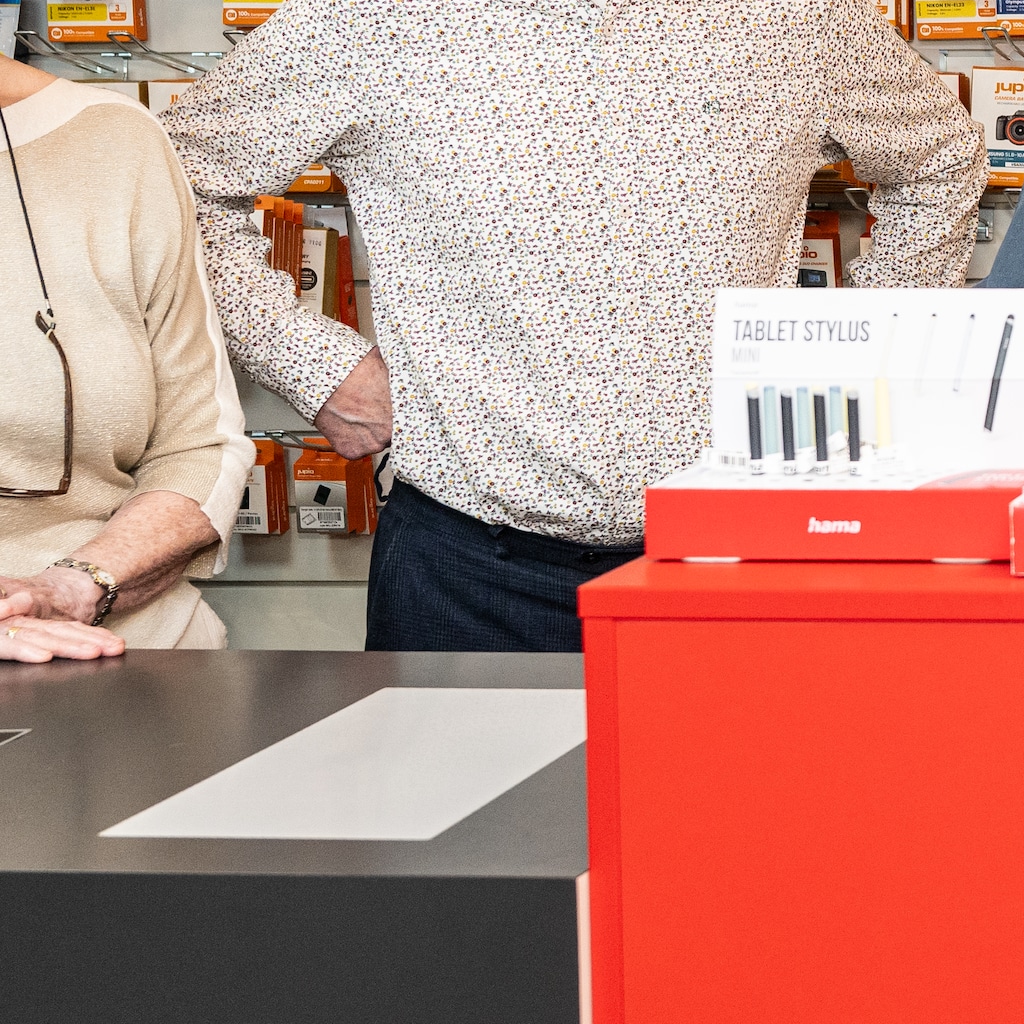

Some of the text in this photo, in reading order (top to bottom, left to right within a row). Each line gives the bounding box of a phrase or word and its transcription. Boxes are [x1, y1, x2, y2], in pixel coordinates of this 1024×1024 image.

[733, 320, 870, 342] TABLET STYLUS
[731, 347, 760, 363] MINI
[807, 517, 861, 534] hama
